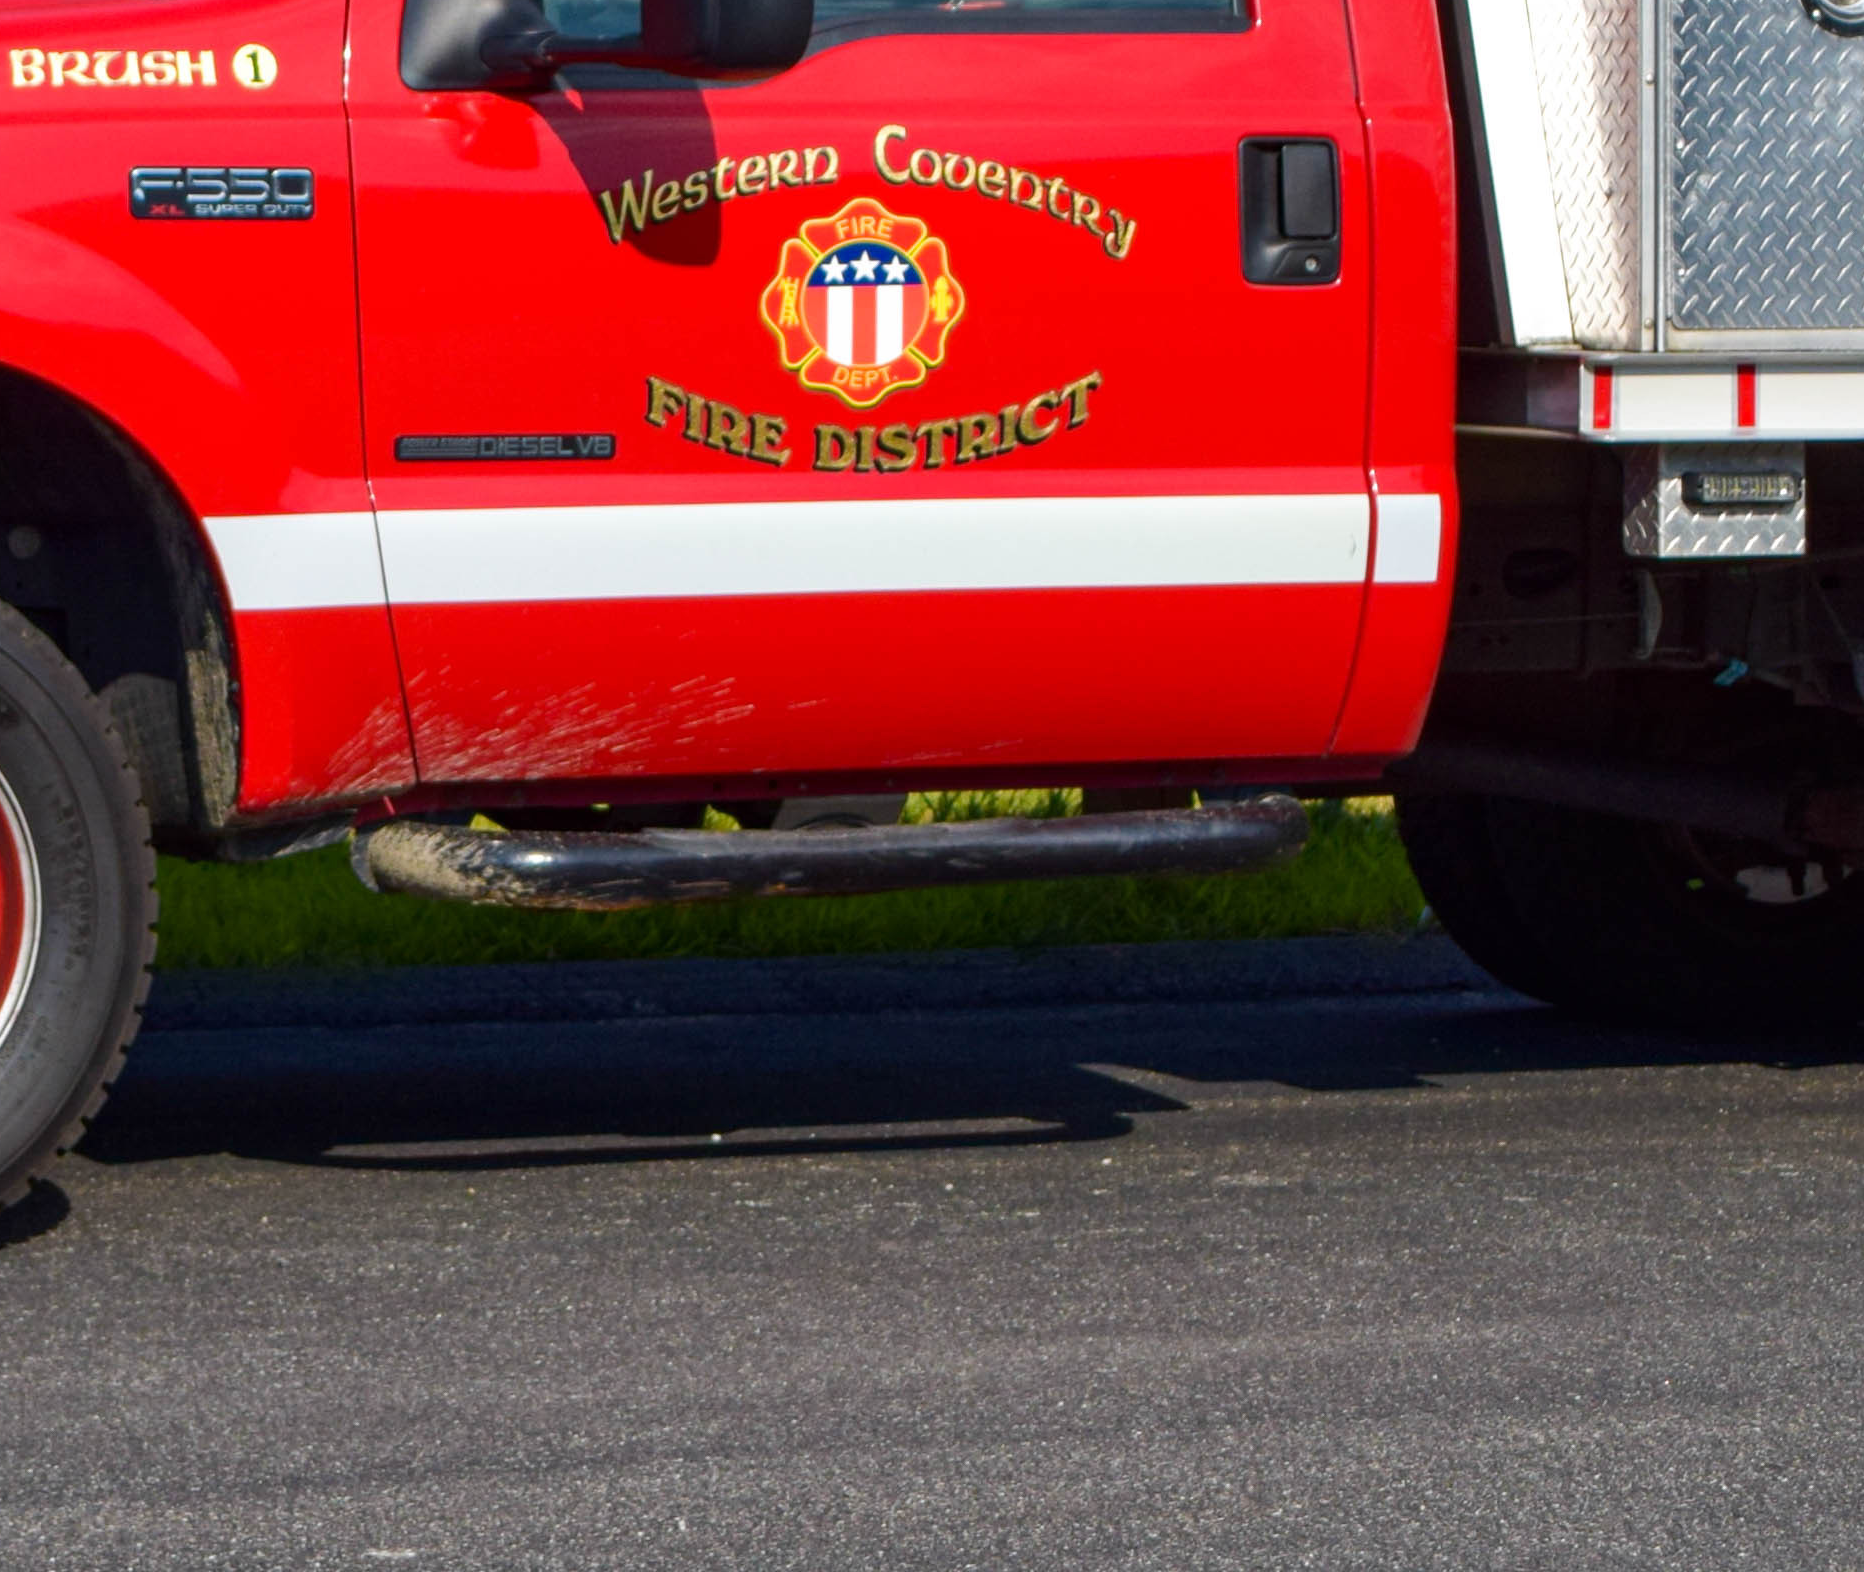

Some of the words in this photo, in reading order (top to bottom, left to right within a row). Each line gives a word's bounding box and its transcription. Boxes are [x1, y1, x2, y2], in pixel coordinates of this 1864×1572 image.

[9, 48, 217, 88] BRUSH
[150, 204, 185, 215] XL
[195, 203, 258, 214] SUPER
[264, 203, 312, 215] DUTY
[835, 215, 895, 240] FIRE
[833, 365, 898, 388] DEPT.
[645, 376, 792, 467] FIRE
[812, 371, 1103, 473] DISTRICT
[480, 436, 573, 455] DIESEL
[576, 435, 612, 455] V8
